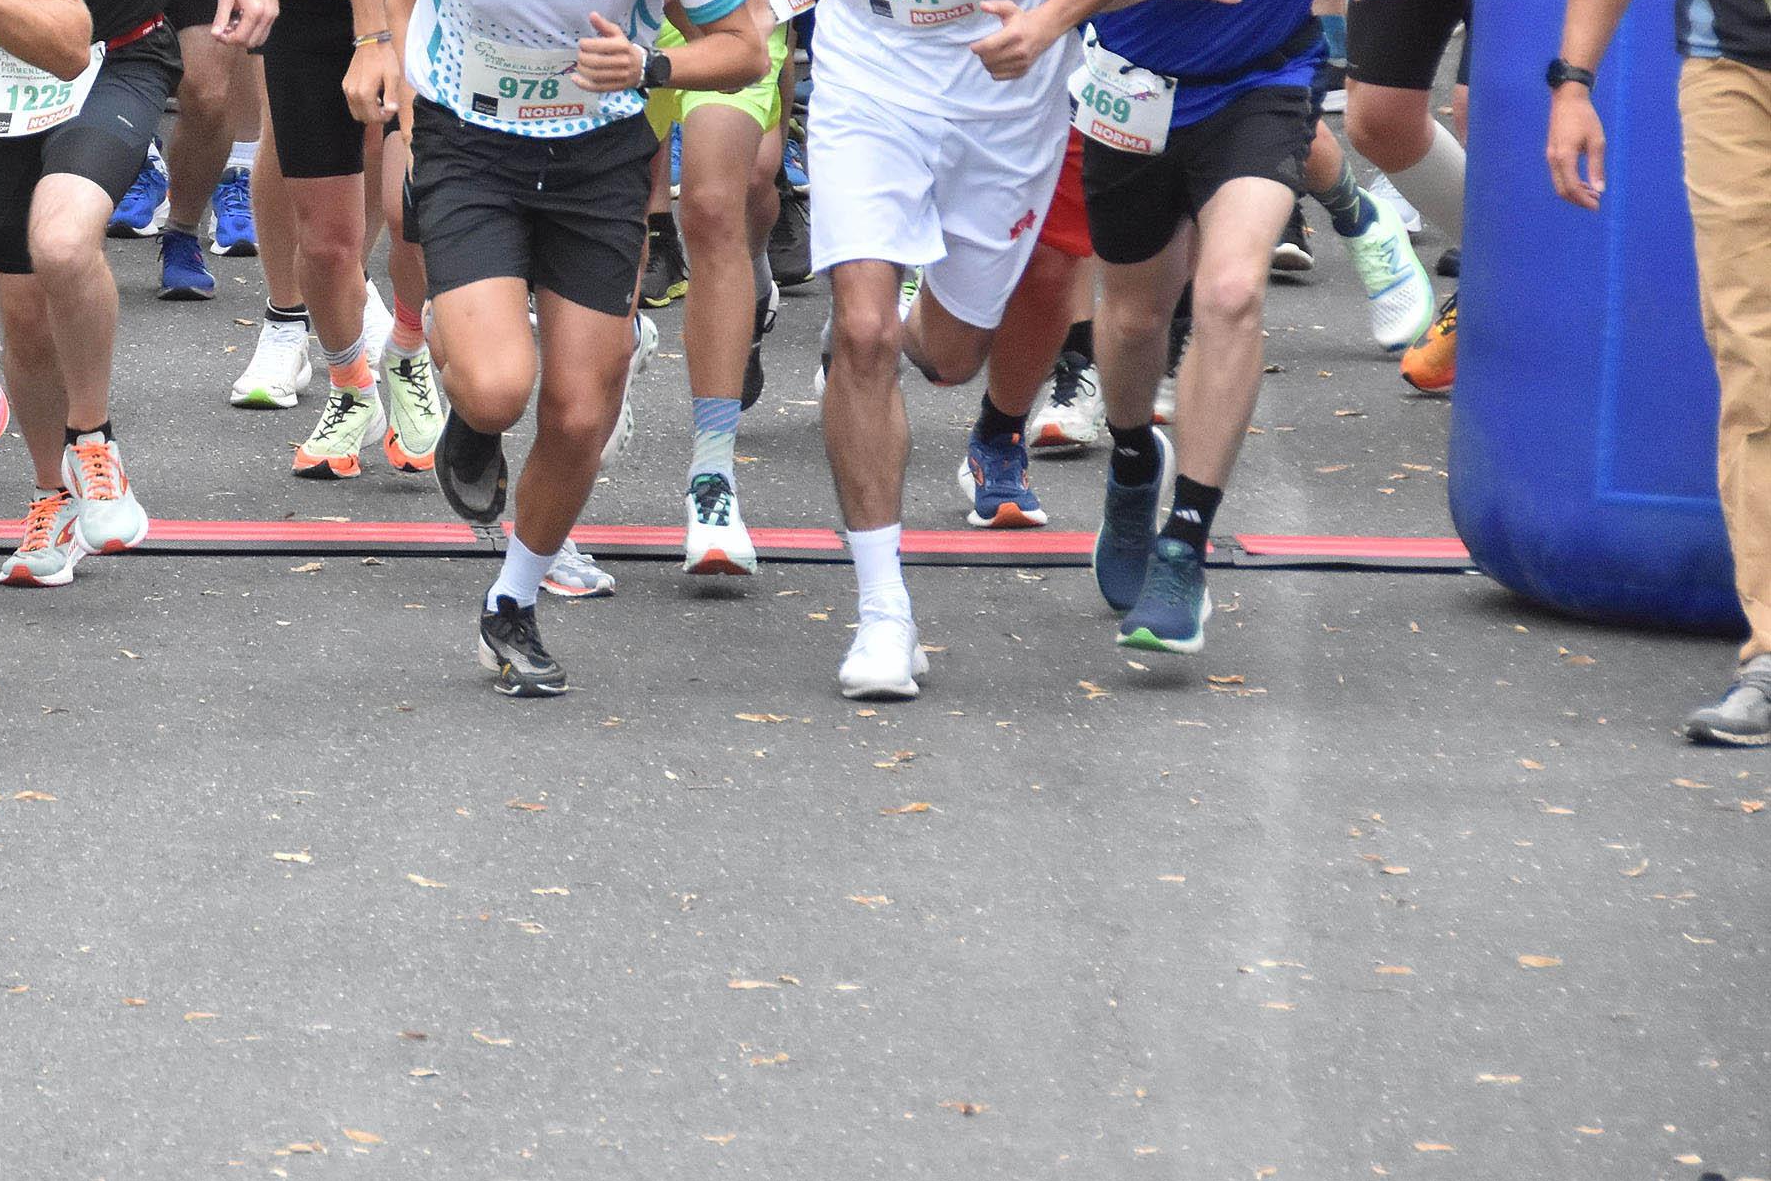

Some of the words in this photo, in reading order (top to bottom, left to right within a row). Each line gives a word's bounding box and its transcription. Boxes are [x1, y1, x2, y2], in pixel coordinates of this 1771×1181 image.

[912, 3, 972, 23] NORMA
[6, 82, 74, 111] 1225
[498, 76, 560, 100] 978
[520, 105, 581, 119] NORMA
[1081, 82, 1131, 123] 469
[27, 106, 73, 130] NORMA
[1092, 122, 1148, 149] NORMA
